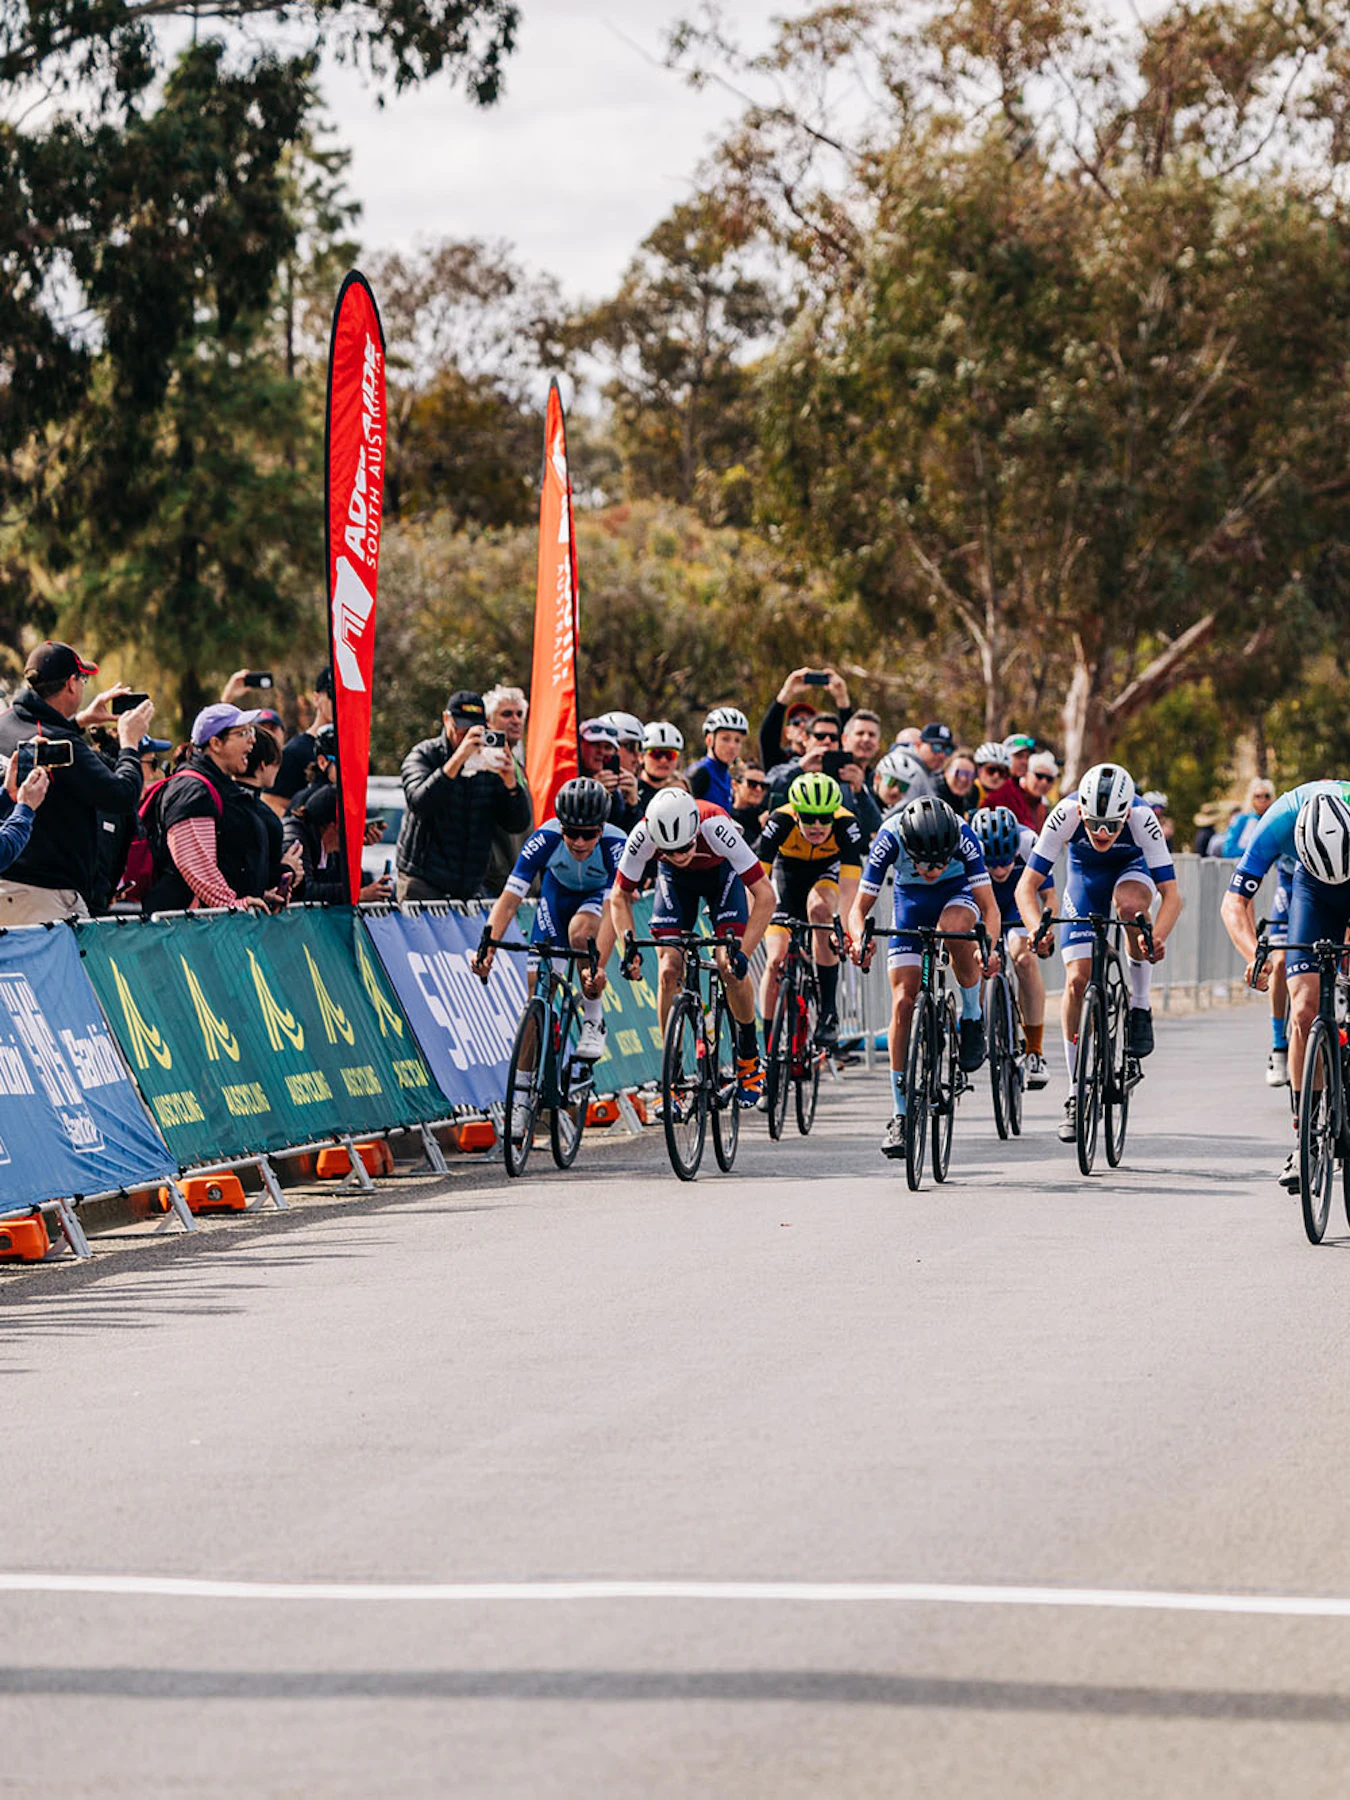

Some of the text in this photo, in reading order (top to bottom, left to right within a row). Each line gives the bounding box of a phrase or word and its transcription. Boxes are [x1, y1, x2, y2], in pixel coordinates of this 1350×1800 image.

[366, 488, 380, 570] SOUTH
[761, 820, 779, 839] WA
[1047, 808, 1067, 832] VIC
[1143, 816, 1162, 840] VIC
[521, 833, 546, 860] NSW
[629, 831, 645, 856] QLD
[714, 825, 736, 848] QLD
[960, 834, 980, 861] NSW
[869, 835, 892, 868] NSW
